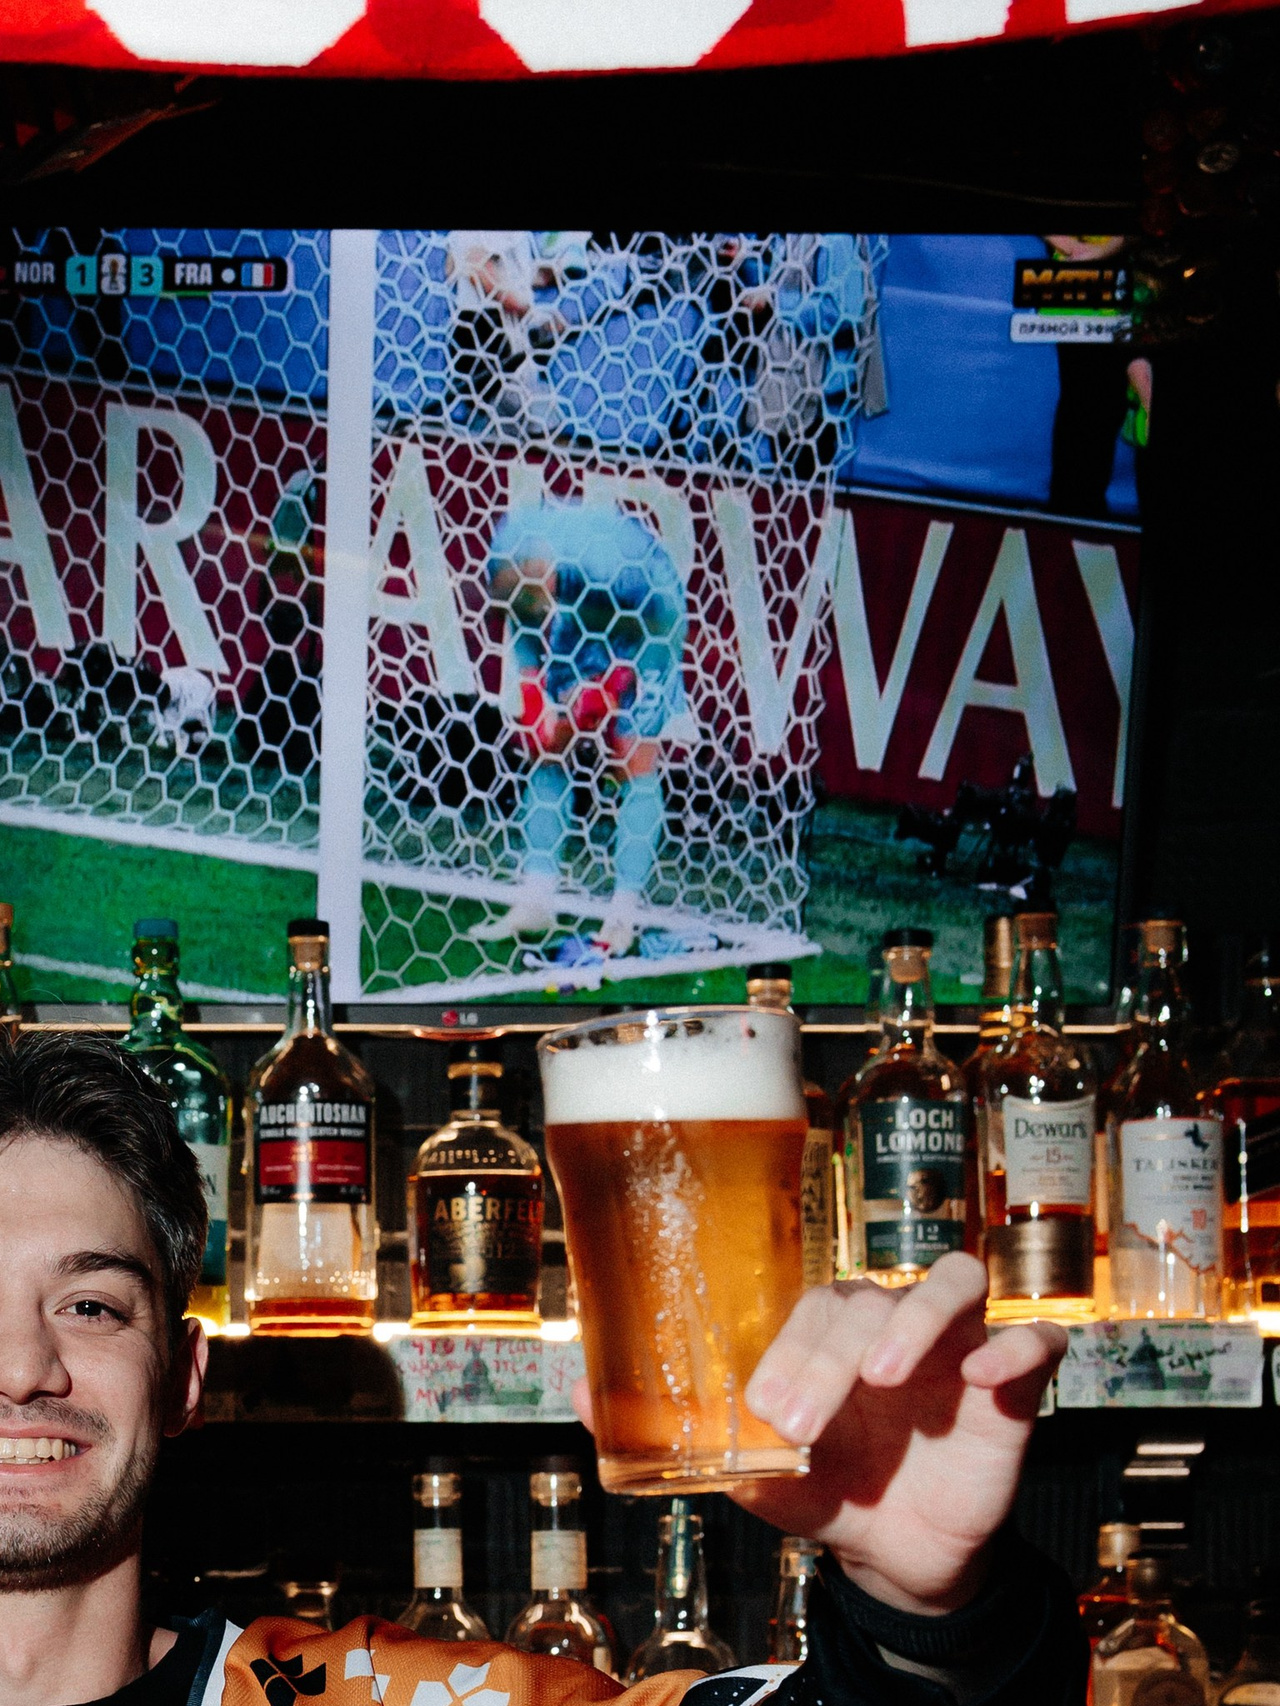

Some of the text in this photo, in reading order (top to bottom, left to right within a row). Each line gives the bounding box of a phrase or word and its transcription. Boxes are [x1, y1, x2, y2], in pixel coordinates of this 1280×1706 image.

[15, 260, 55, 283] NOR
[75, 263, 88, 286] 1
[138, 262, 155, 286] 3
[174, 262, 213, 285] FRA
[1020, 319, 1079, 336] ПРЯМОЙ
[894, 1109, 954, 1130] LOCH
